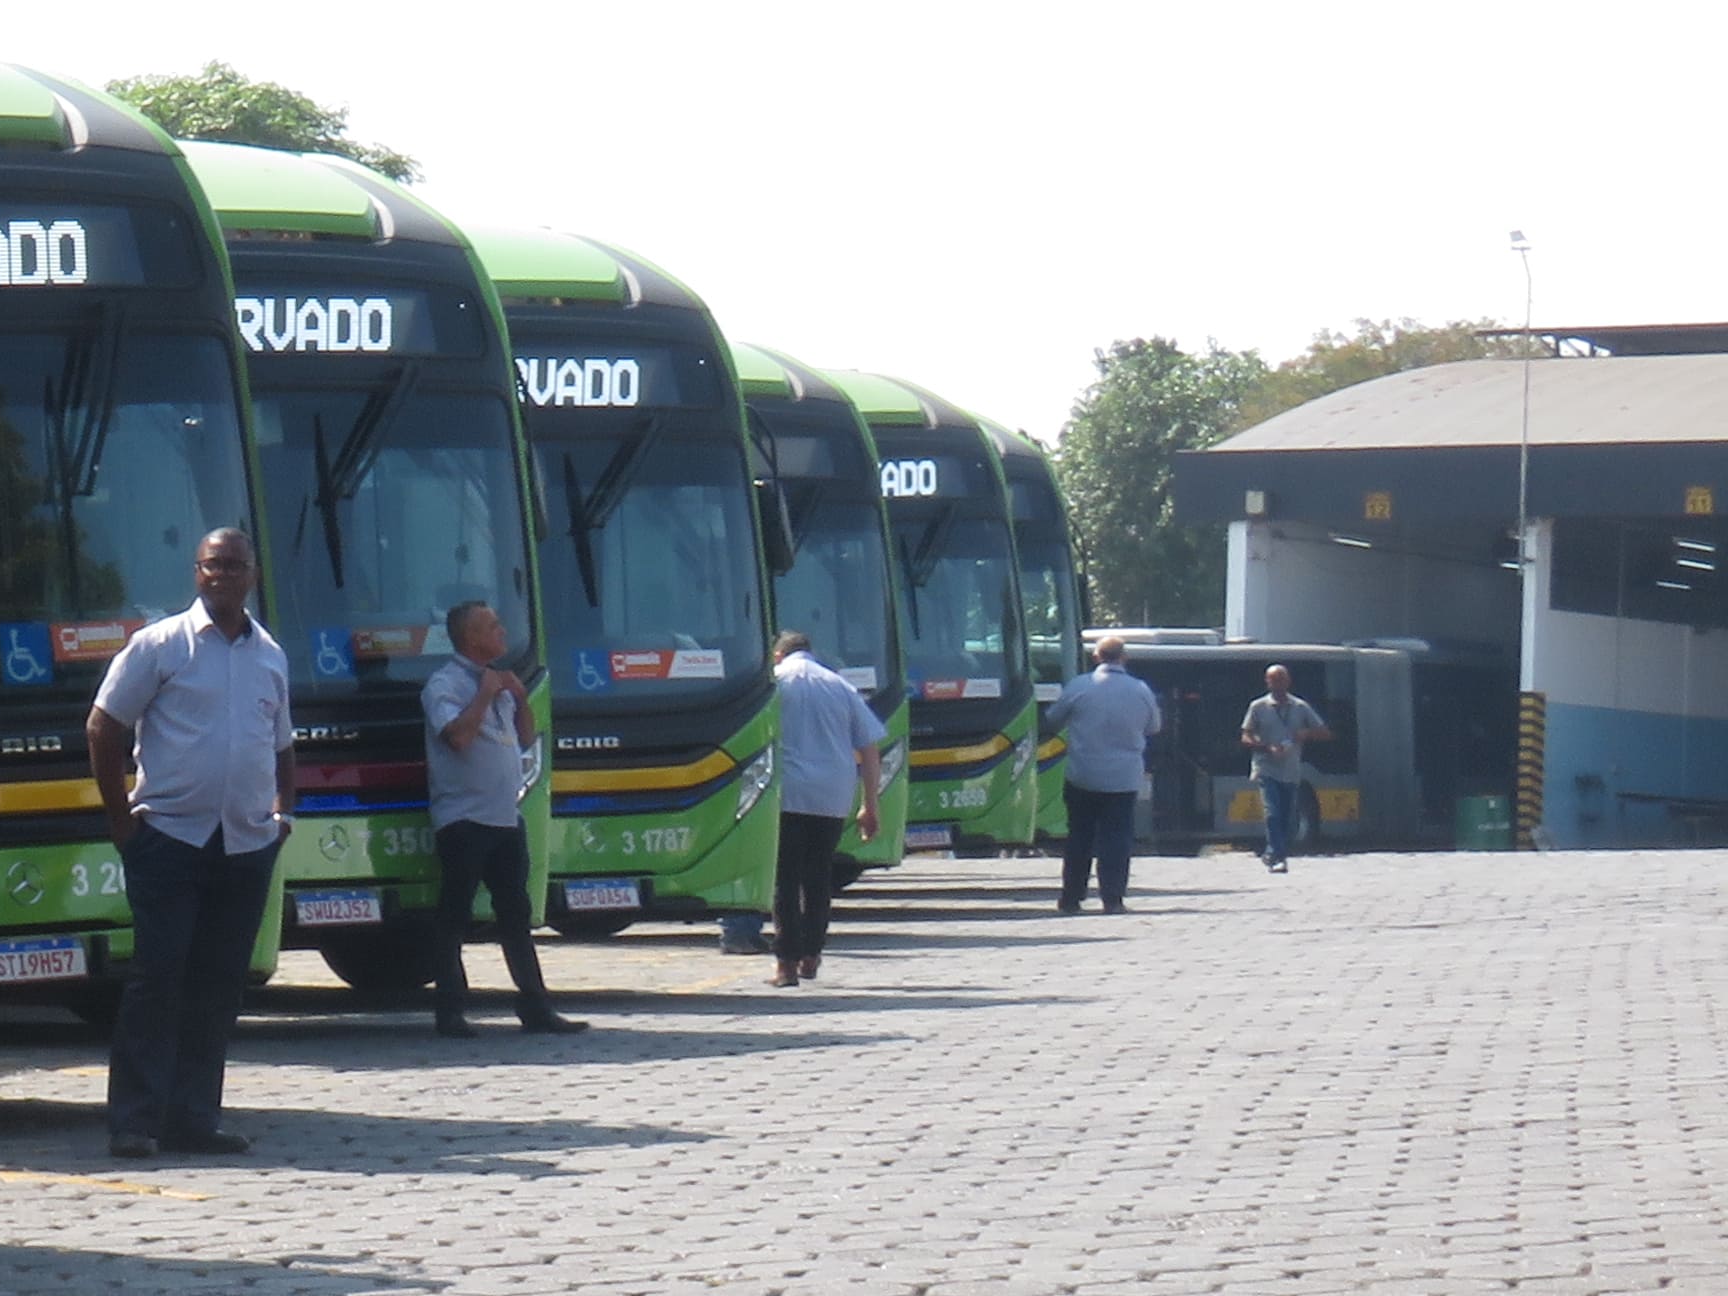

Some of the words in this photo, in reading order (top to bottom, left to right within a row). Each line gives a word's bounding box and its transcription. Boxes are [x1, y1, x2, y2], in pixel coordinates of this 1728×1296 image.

[558, 736, 621, 749] CAIO
[621, 831, 635, 854] 3
[72, 864, 89, 896] 3
